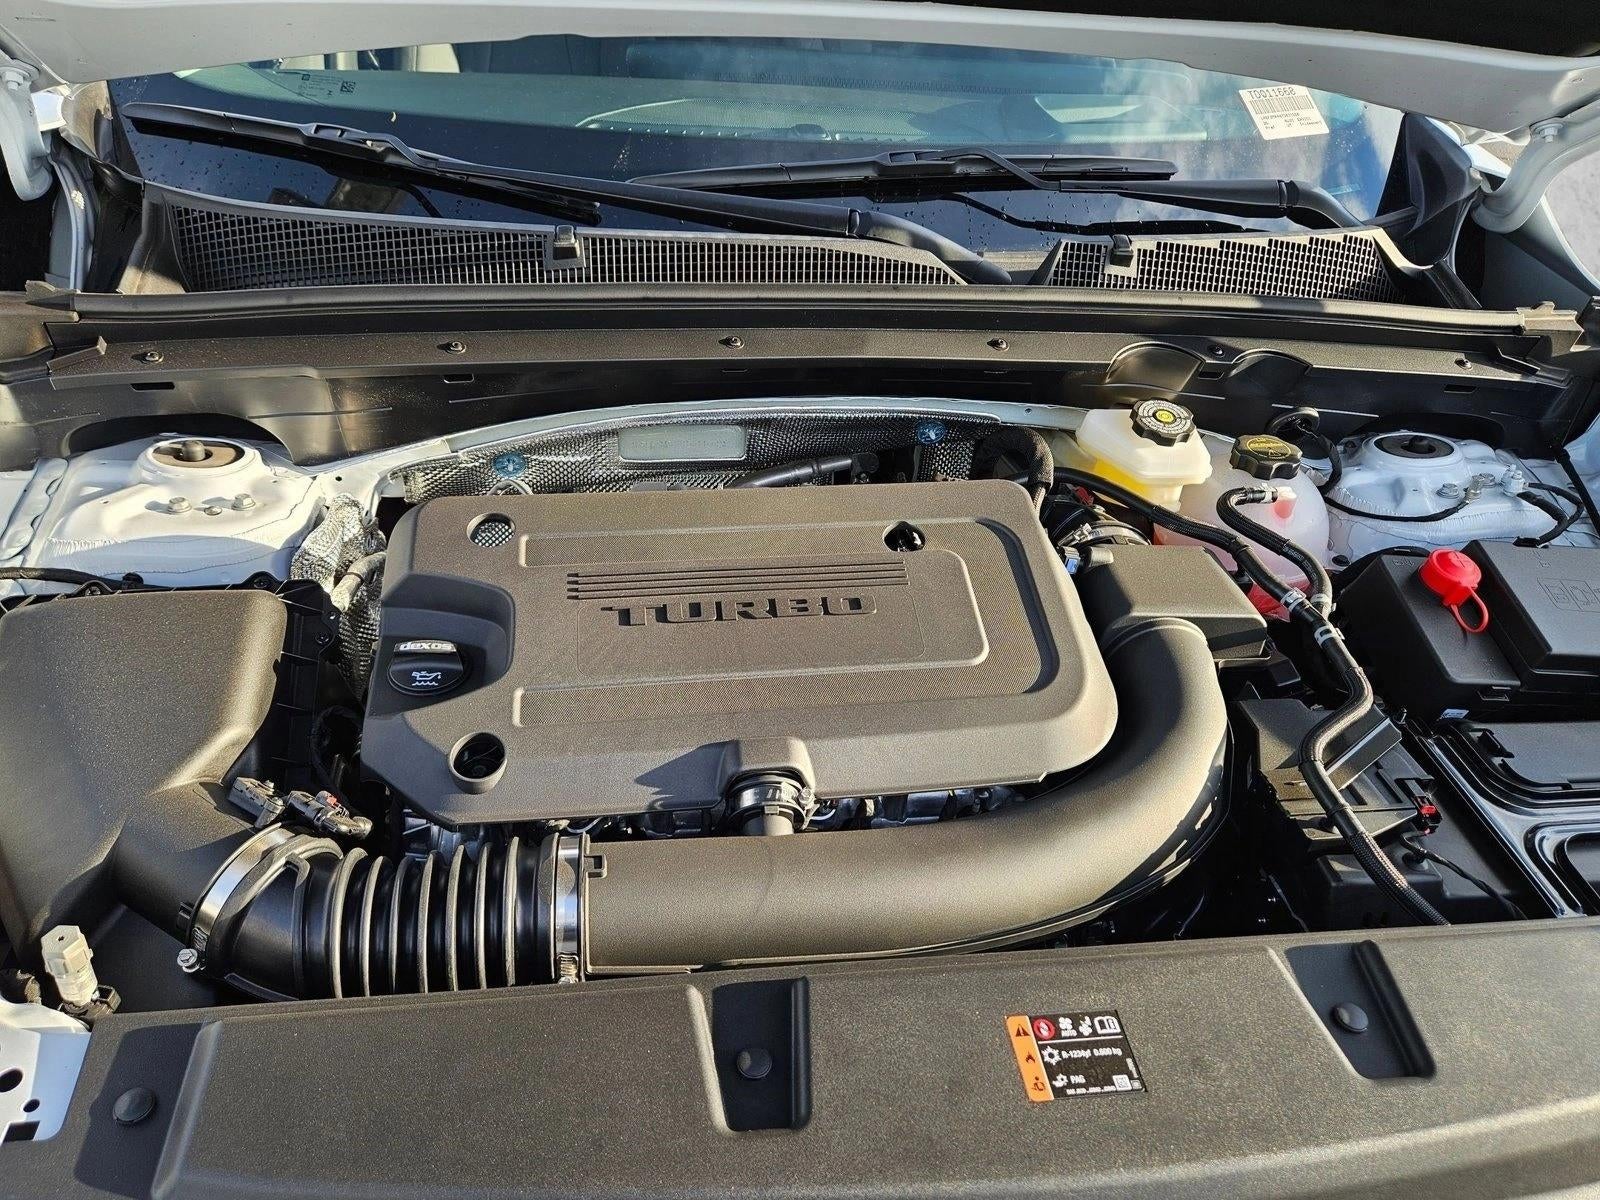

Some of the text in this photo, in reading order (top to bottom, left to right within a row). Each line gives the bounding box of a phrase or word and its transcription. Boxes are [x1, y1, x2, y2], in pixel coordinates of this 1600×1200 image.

[601, 596, 877, 626] TURBO
[399, 642, 452, 651] dexos
[1070, 1074, 1086, 1084] PAG
